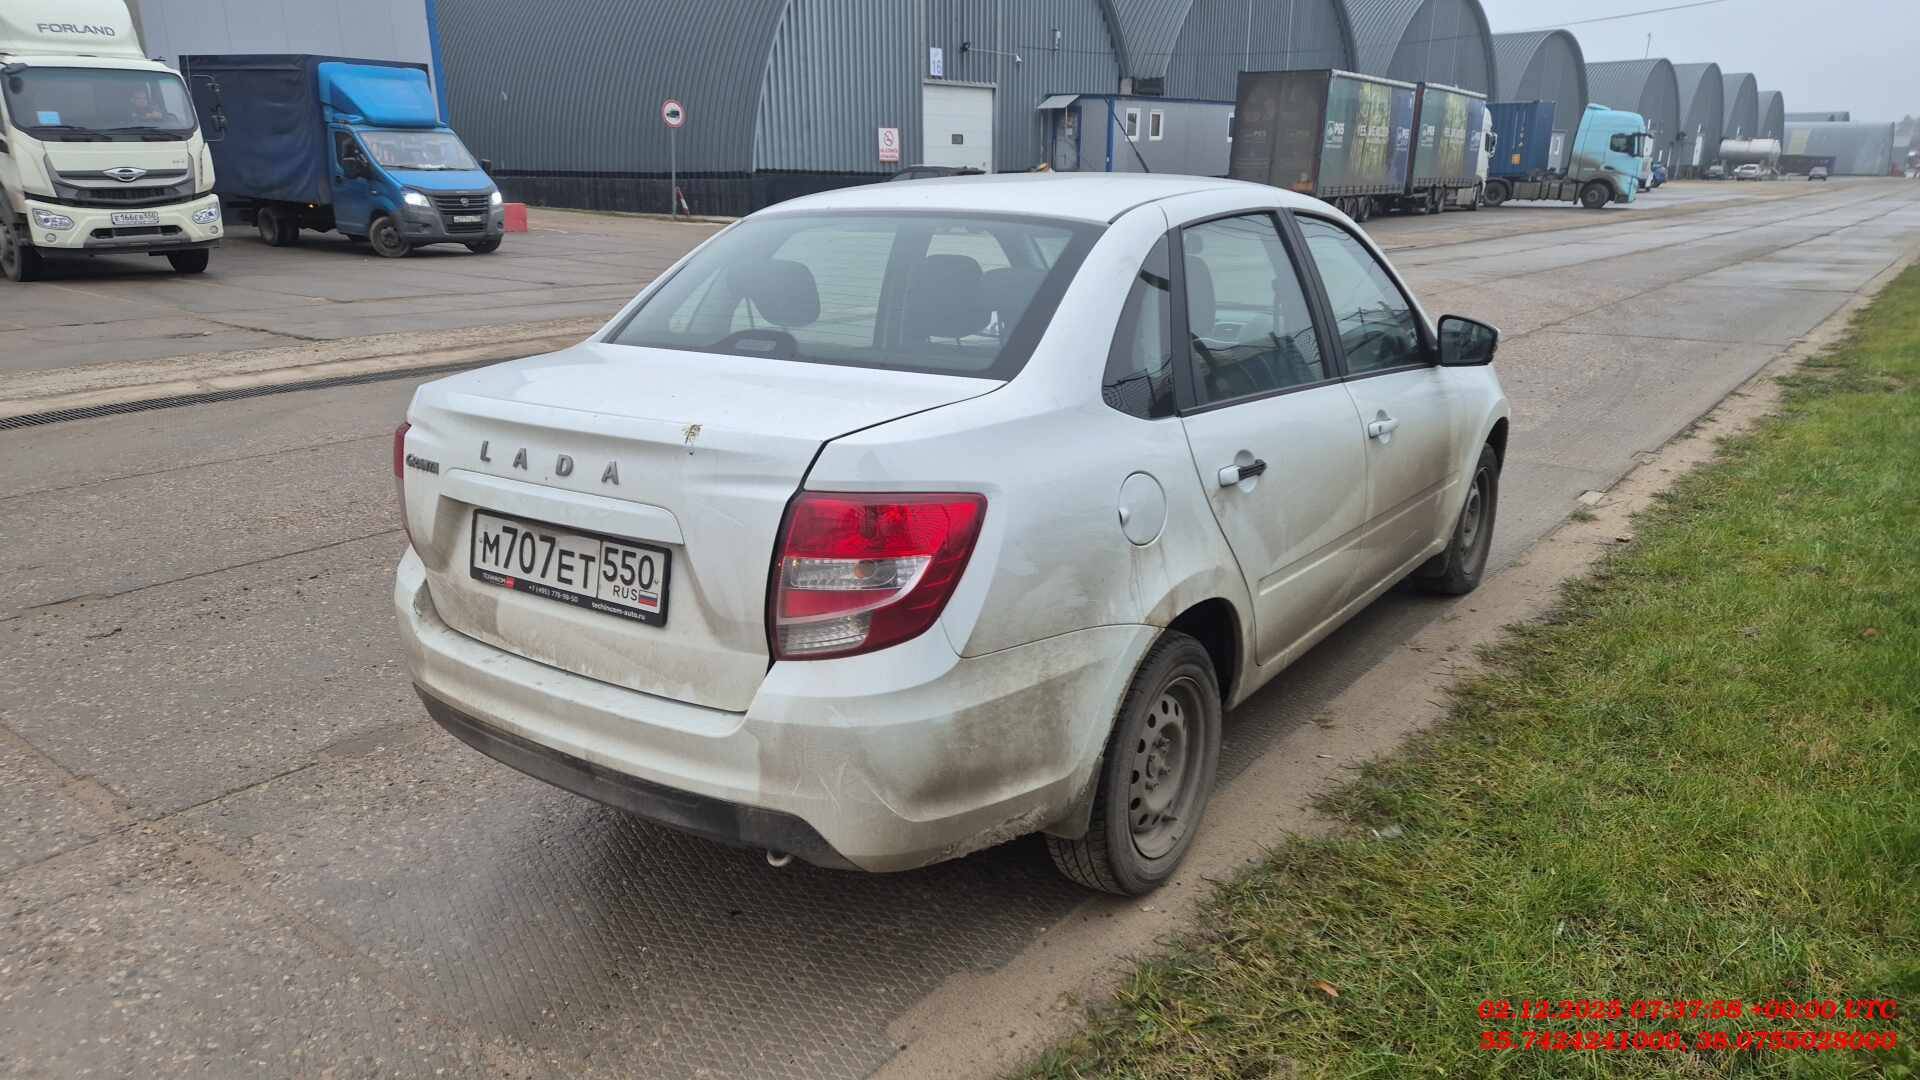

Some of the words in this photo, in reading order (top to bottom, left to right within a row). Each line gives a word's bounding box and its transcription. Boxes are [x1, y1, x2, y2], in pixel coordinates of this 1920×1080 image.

[36, 23, 116, 37] FORLAND
[480, 440, 619, 485] LADA
[482, 525, 596, 589] М707ЕТ
[602, 546, 655, 590] 550
[612, 584, 638, 601] RUS
